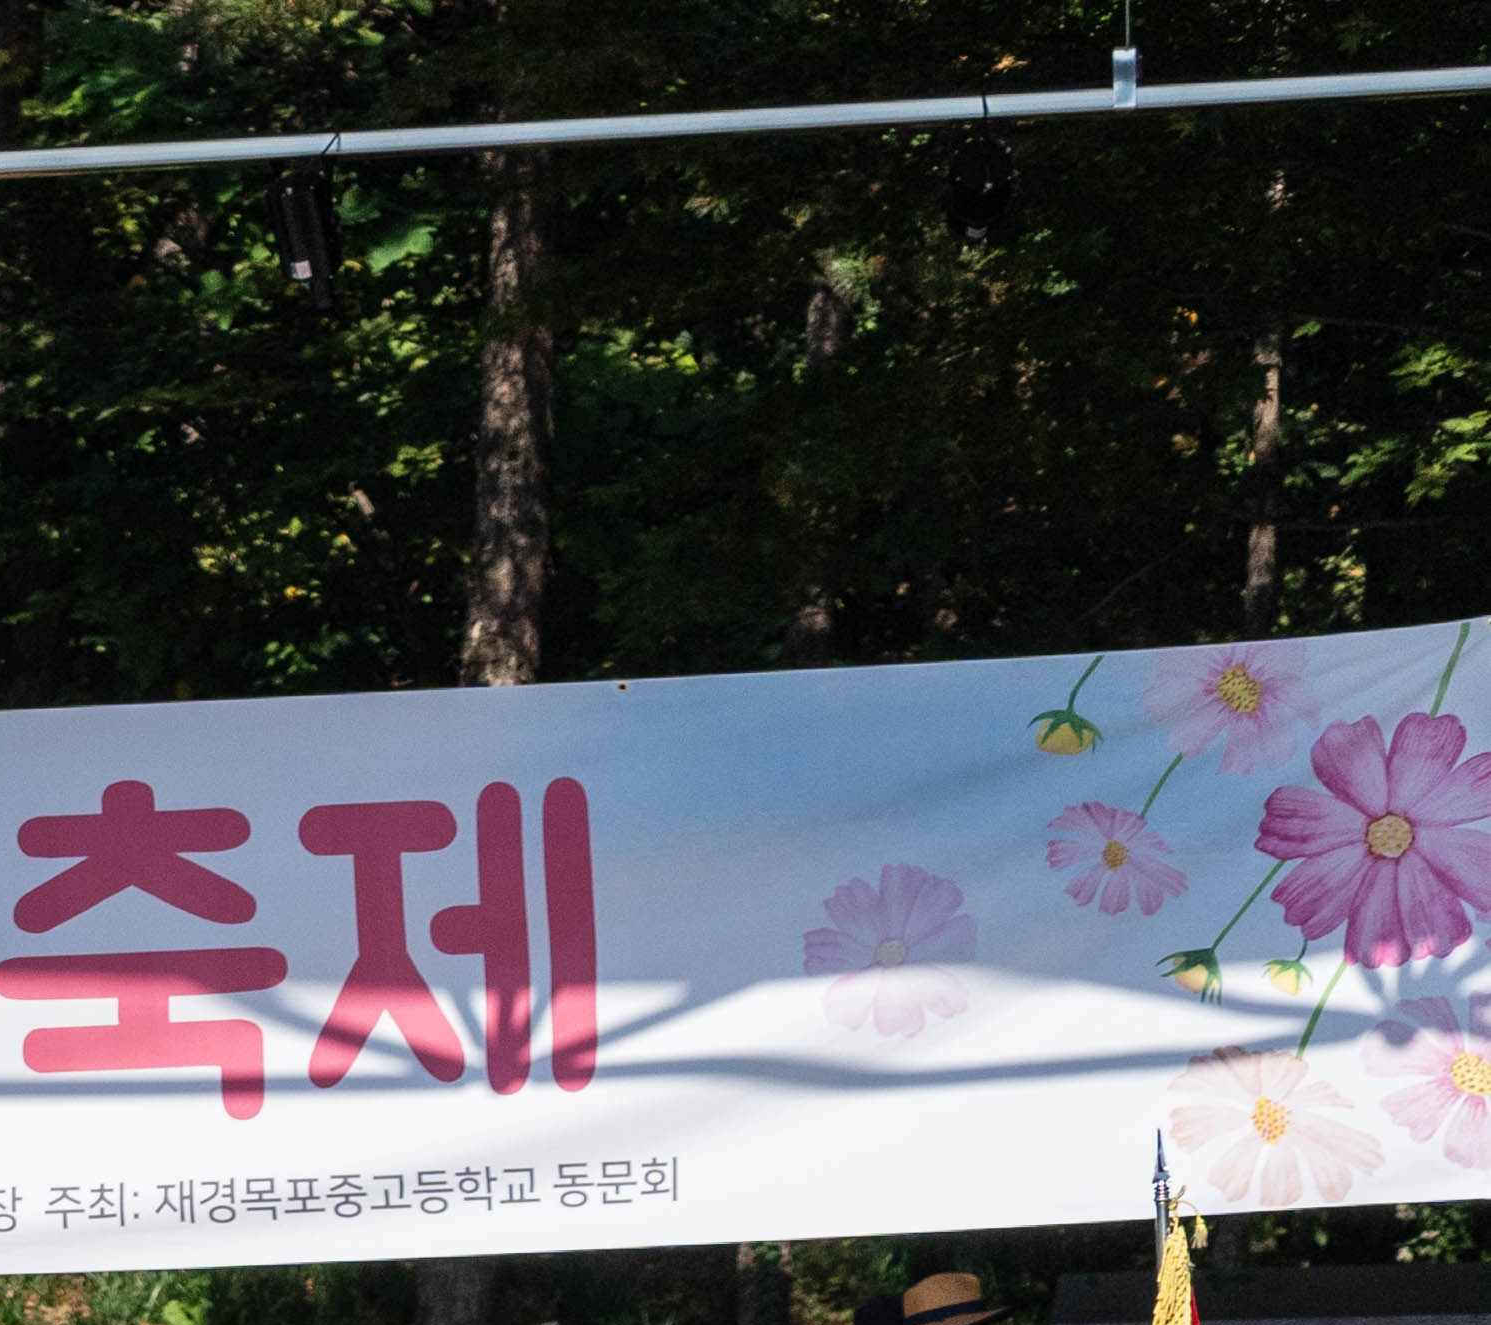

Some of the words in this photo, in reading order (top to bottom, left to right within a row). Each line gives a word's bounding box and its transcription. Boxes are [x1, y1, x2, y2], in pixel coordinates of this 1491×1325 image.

[45, 1182, 140, 1230] 주최:
[156, 1165, 541, 1225] 재경목포중고등학교
[554, 1156, 679, 1207] 동문회
